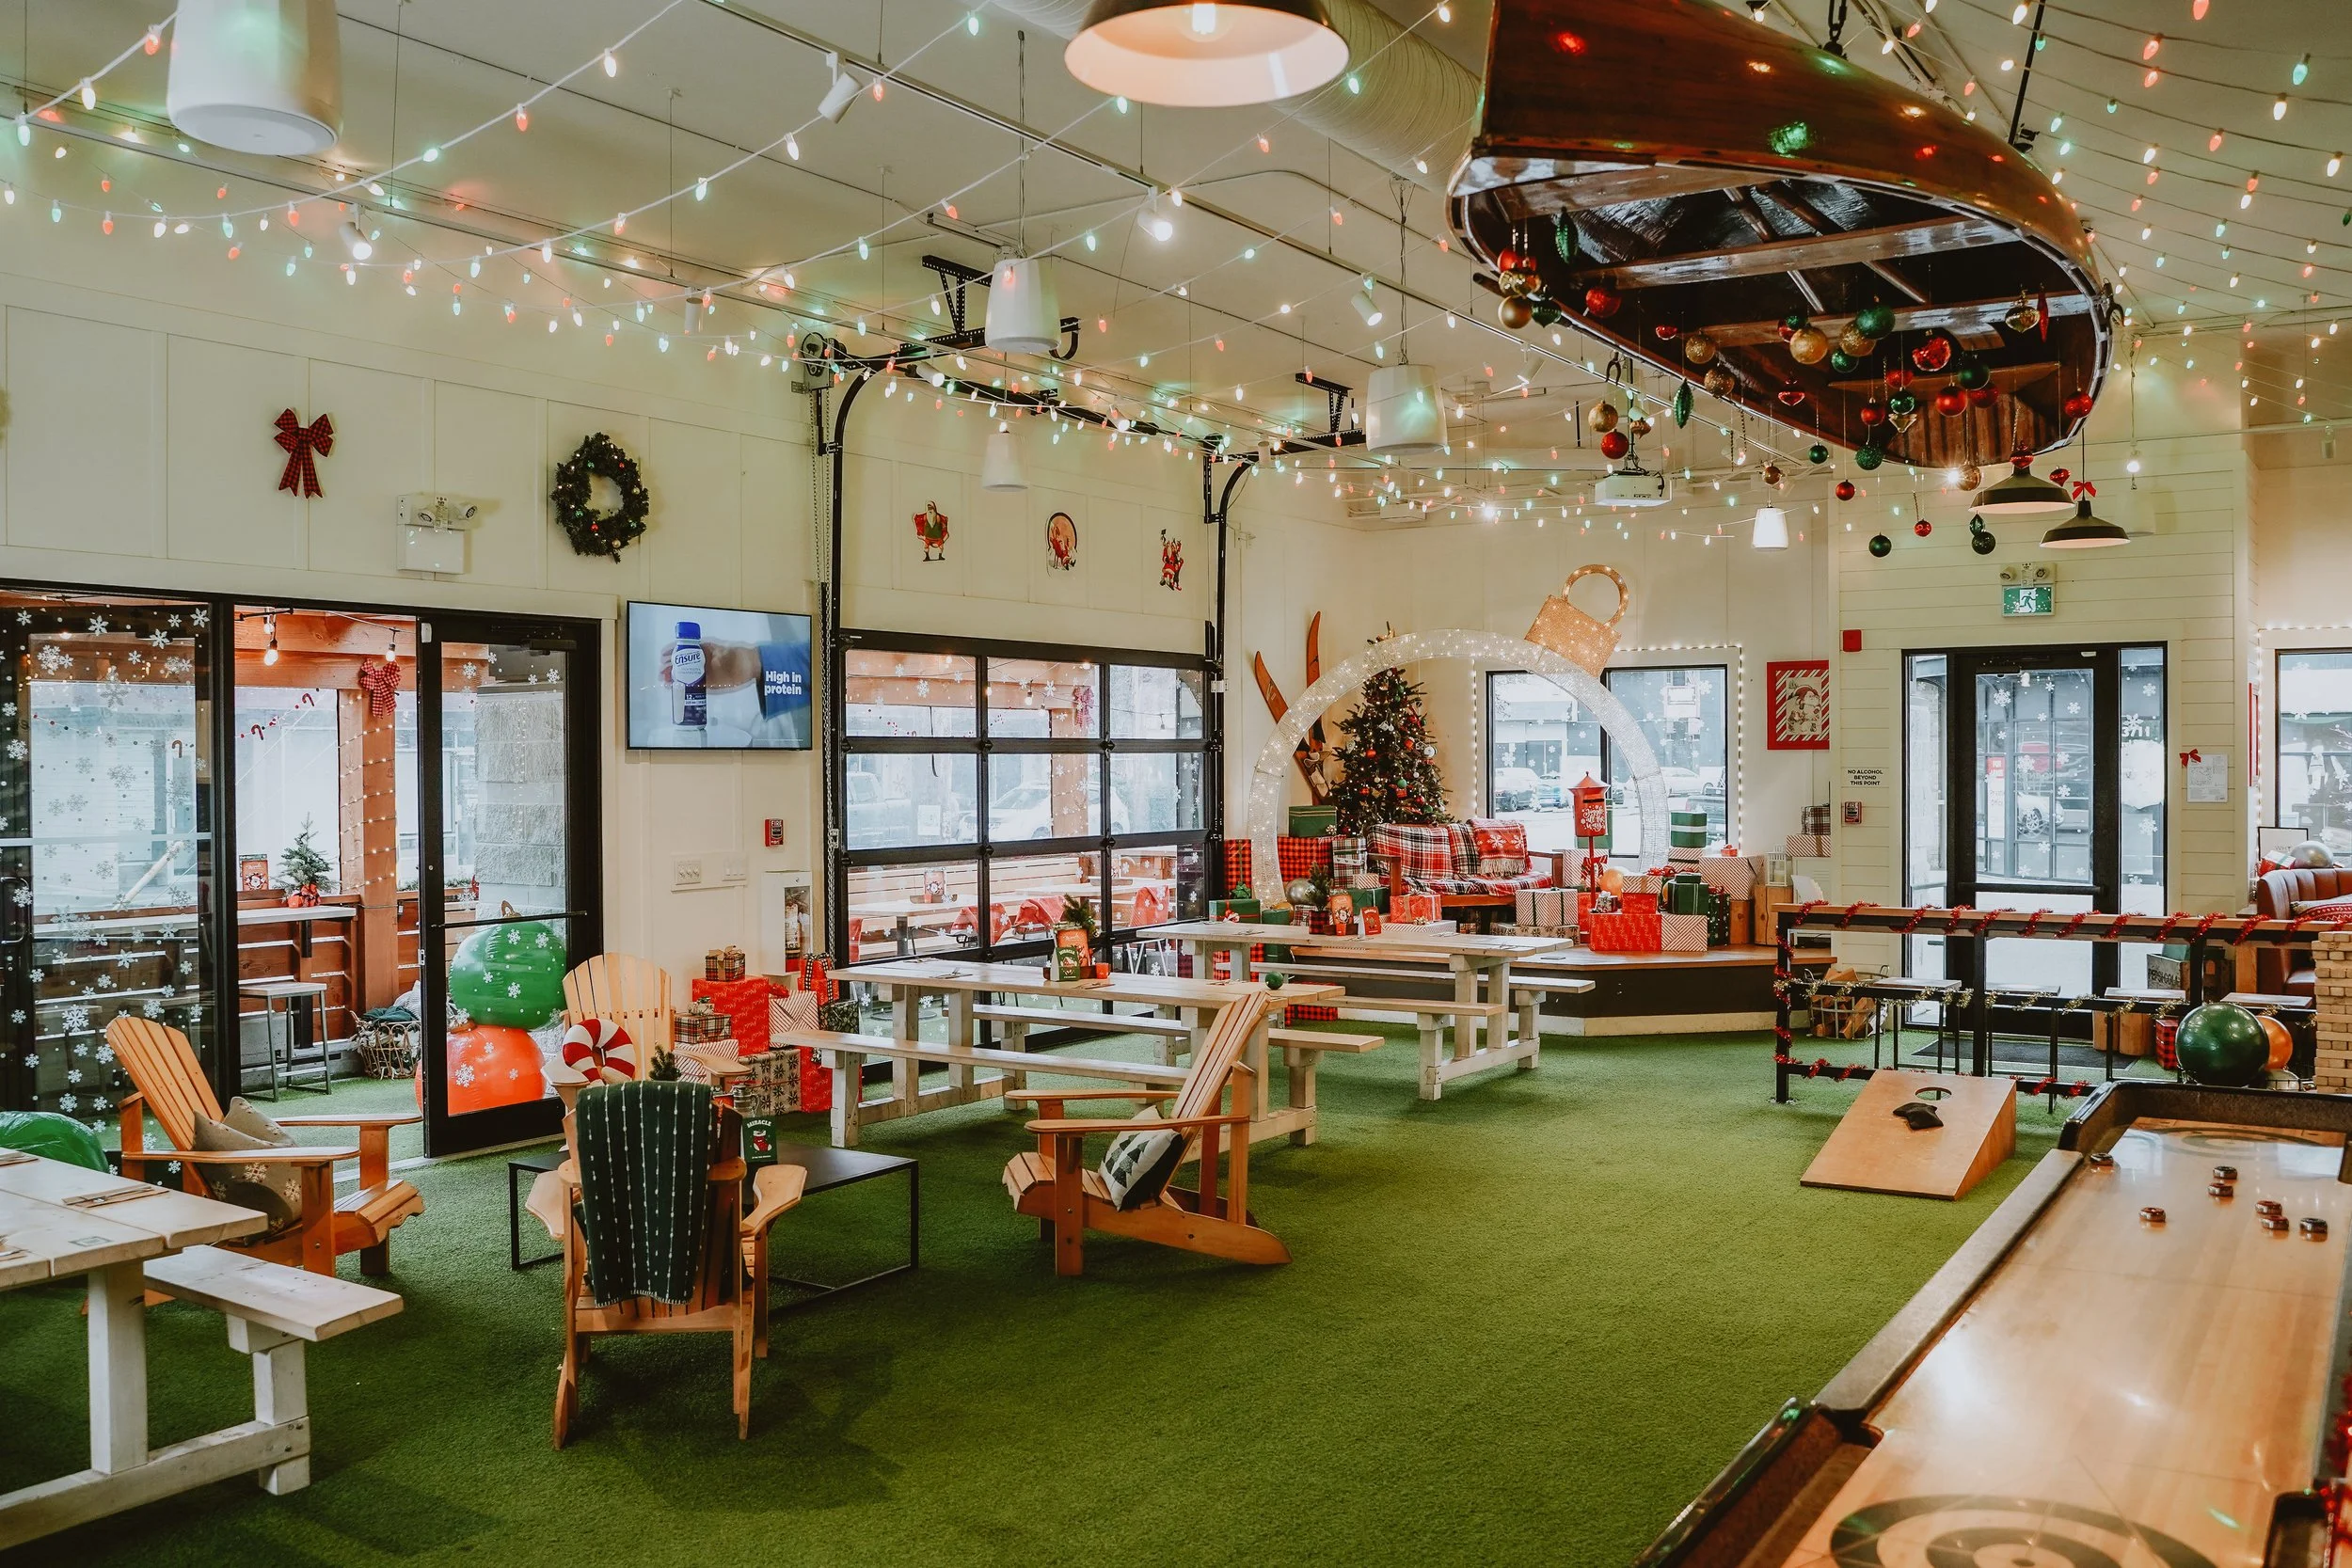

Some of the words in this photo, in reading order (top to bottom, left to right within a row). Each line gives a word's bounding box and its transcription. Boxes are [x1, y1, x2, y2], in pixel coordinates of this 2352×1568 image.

[675, 652, 701, 665] Ensure
[766, 671, 789, 684] High
[791, 672, 803, 683] in
[764, 684, 802, 695] protein
[746, 1119, 772, 1129] MIRACLE
